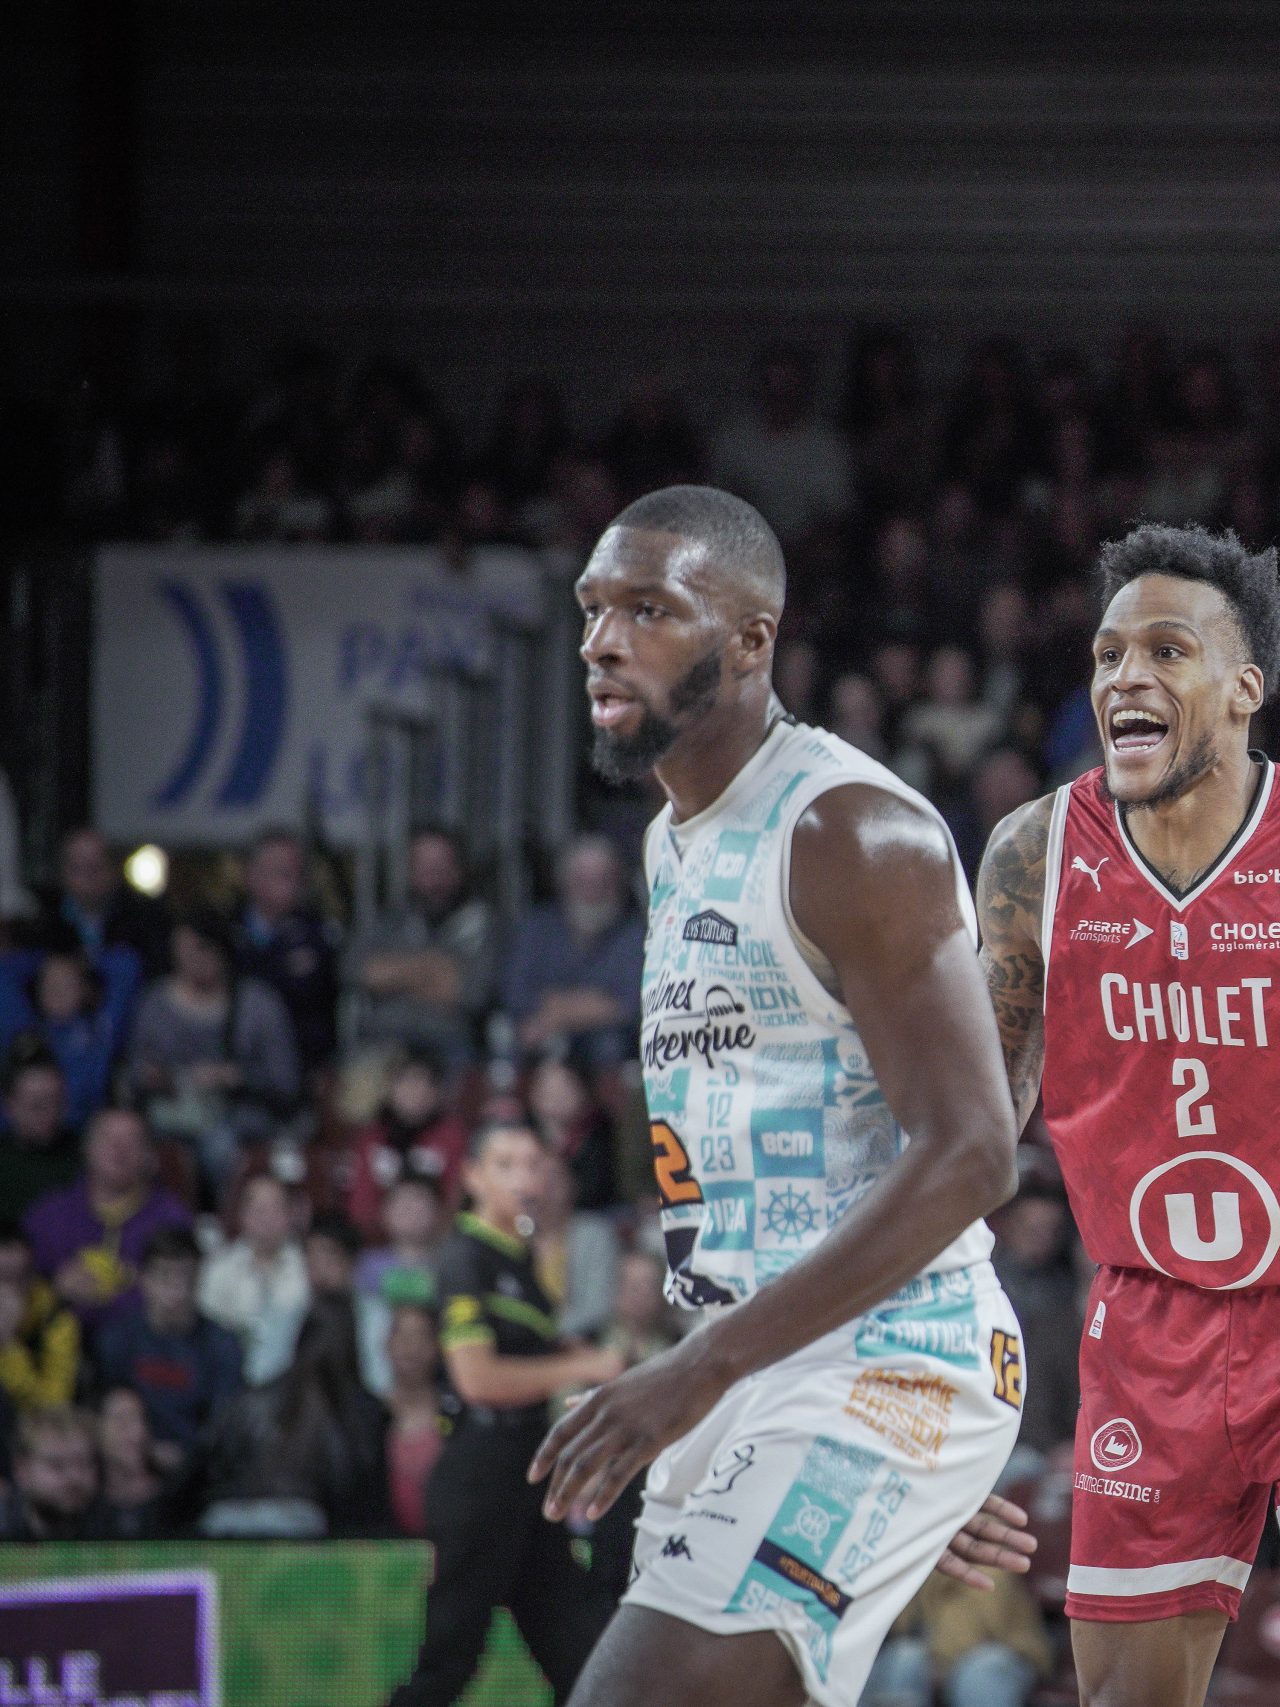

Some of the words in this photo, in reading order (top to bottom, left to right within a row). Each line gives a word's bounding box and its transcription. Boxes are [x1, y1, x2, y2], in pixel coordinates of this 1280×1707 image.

[700, 917, 735, 943] TOITURE
[1069, 930, 1121, 944] Transports
[1100, 972, 1272, 1047] CHOLET
[1172, 1058, 1217, 1137] 2
[1164, 1191, 1243, 1261] U
